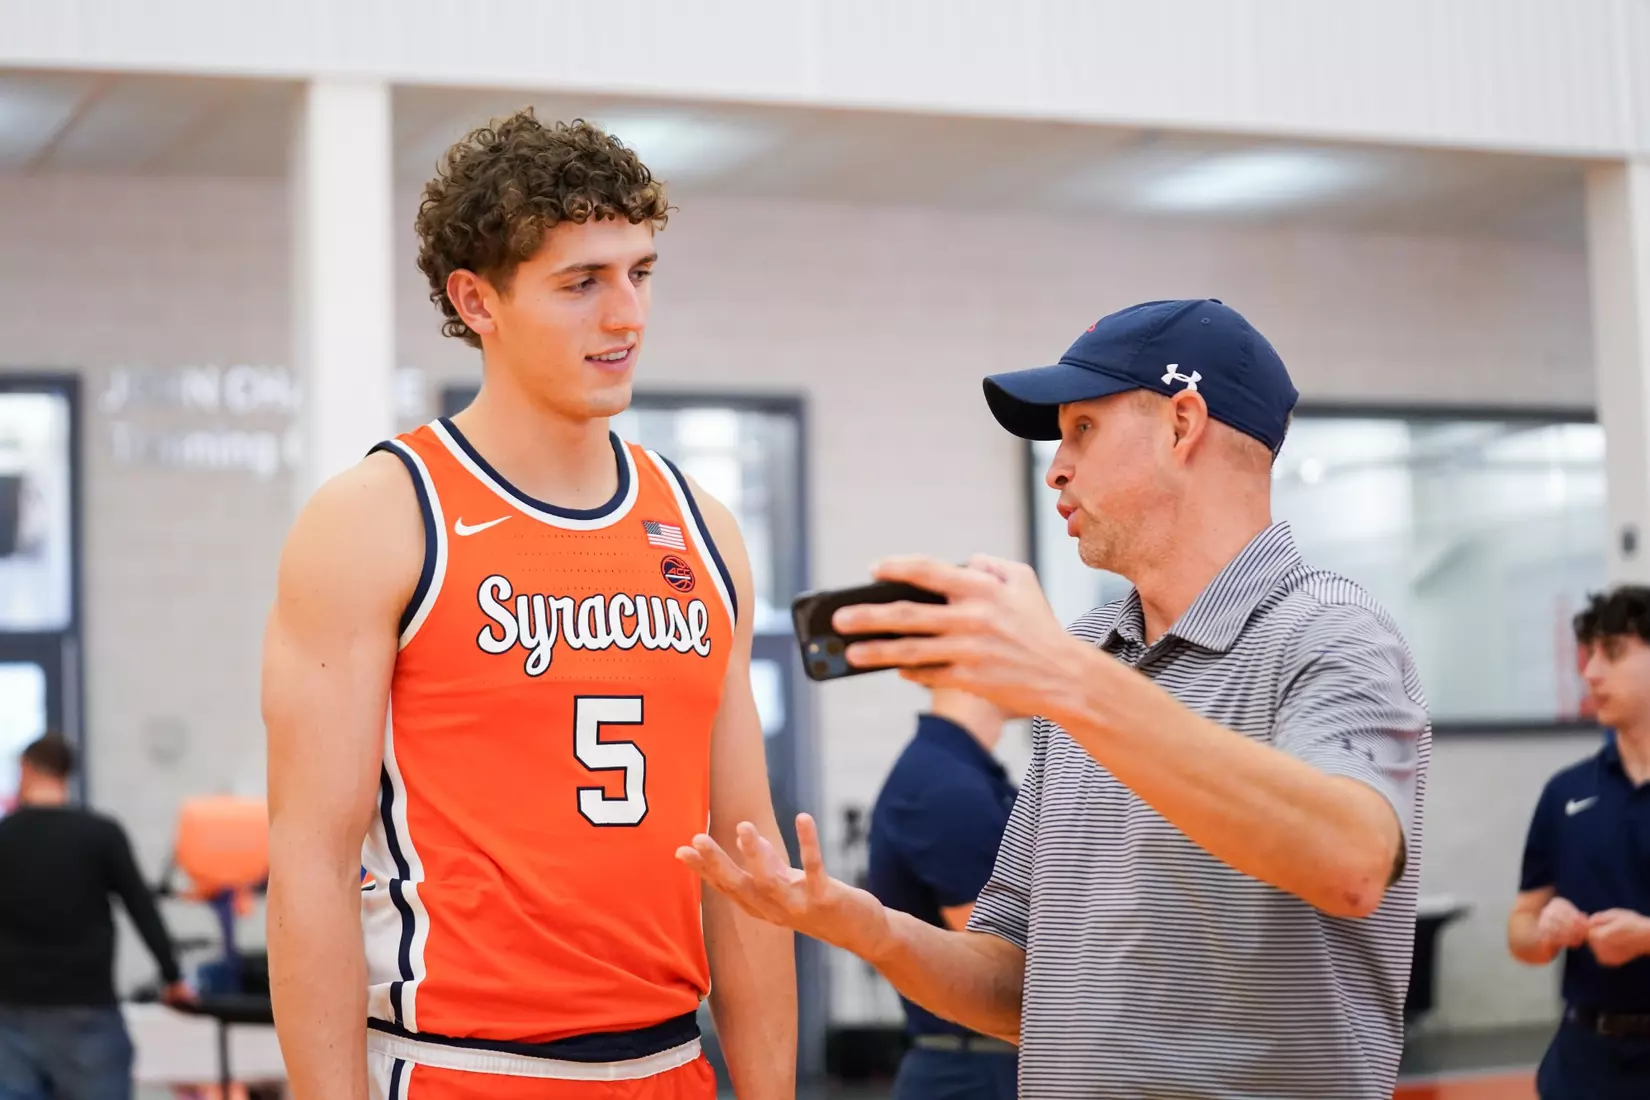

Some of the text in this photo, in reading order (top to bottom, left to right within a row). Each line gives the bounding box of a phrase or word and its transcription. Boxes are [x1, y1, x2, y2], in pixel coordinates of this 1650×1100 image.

[667, 567, 690, 576] ACC
[477, 574, 710, 676] Syracuse
[573, 695, 649, 827] 5
